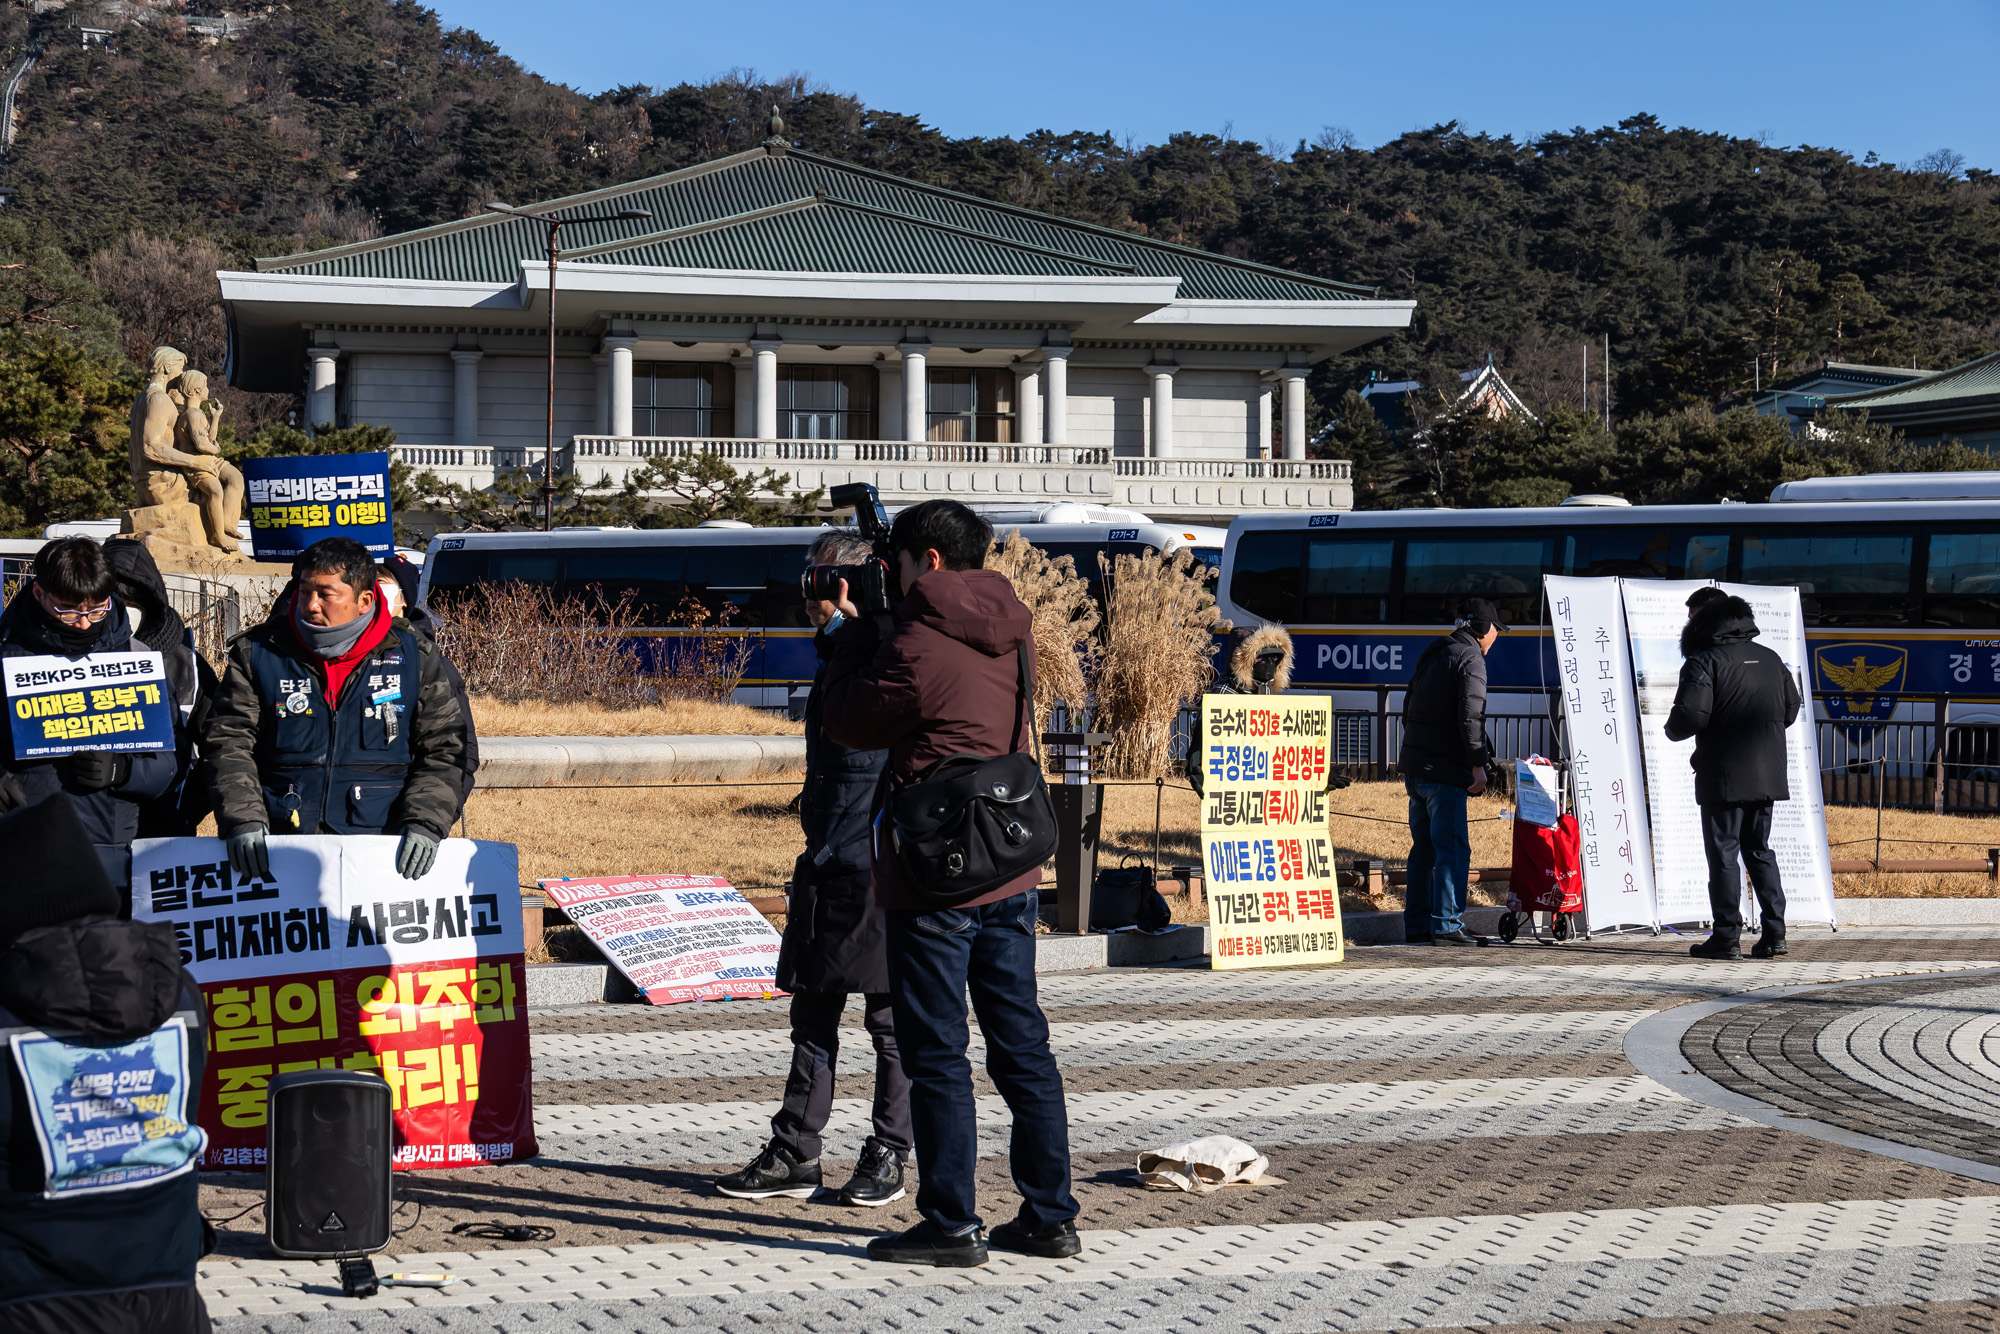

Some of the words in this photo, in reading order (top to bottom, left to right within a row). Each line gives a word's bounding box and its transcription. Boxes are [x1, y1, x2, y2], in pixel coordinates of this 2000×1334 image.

[248, 473, 385, 503] 발전비정규직
[251, 504, 331, 529] 정규직화
[335, 502, 387, 526] 이행!
[1311, 516, 1337, 525] 26기-3
[1110, 530, 1136, 540] 27기-2
[1317, 644, 1403, 670] POLICE
[1556, 596, 1582, 714] 대통령님
[14, 667, 86, 688] 한전KPS
[90, 660, 154, 678] 직접고용
[280, 678, 312, 694] 단결
[1594, 626, 1618, 745] 추모관이
[15, 691, 87, 719] 이재명
[90, 684, 161, 710] 정부가
[42, 710, 145, 740] 책임져라!
[1210, 708, 1247, 737] 공수처
[1249, 709, 1280, 737] 531호
[1282, 709, 1327, 737] 수사하라!
[1209, 745, 1268, 781] 국정원의
[1272, 745, 1325, 781] 살인청부
[1208, 789, 1299, 826] 교통사고(즉사)
[1301, 790, 1325, 824] 시도
[1575, 749, 1600, 867] 순국선열
[1611, 778, 1638, 893] 위기예요
[1210, 840, 1253, 883] 아파트
[1253, 839, 1276, 882] 2동
[1277, 838, 1304, 881] 강탈
[1306, 838, 1330, 879] 시도
[150, 860, 279, 914] 발전소
[549, 883, 611, 903] 이재명
[608, 880, 658, 894] 대통령님
[346, 893, 502, 948] 사망사고
[567, 903, 604, 920] GS건설
[1214, 893, 1260, 924] 17년간
[1262, 891, 1295, 923] 공작,
[1296, 889, 1335, 921] 독극물
[580, 923, 593, 932] 1.
[589, 913, 622, 928] GS건설
[591, 931, 605, 941] 2.
[601, 919, 647, 936] 주거생존권
[605, 934, 639, 951] 이재명
[636, 927, 677, 945] 대통령님
[1218, 936, 1244, 957] 아파트
[1245, 935, 1263, 956] 공실
[1264, 933, 1301, 954] 95개월째
[1301, 932, 1319, 952] (2월
[1319, 931, 1338, 951] 기준)
[622, 956, 646, 968] 이재명
[628, 966, 649, 980] 마지막
[714, 966, 766, 980] 대통령실
[668, 988, 694, 999] 마포구
[733, 982, 763, 993] GS건설
[203, 979, 338, 1053] 험의
[357, 963, 516, 1036] 외주화
[217, 1043, 479, 1128] 중하라!
[65, 1122, 143, 1153] 노정교섭
[448, 1143, 513, 1162] 대책위원회
